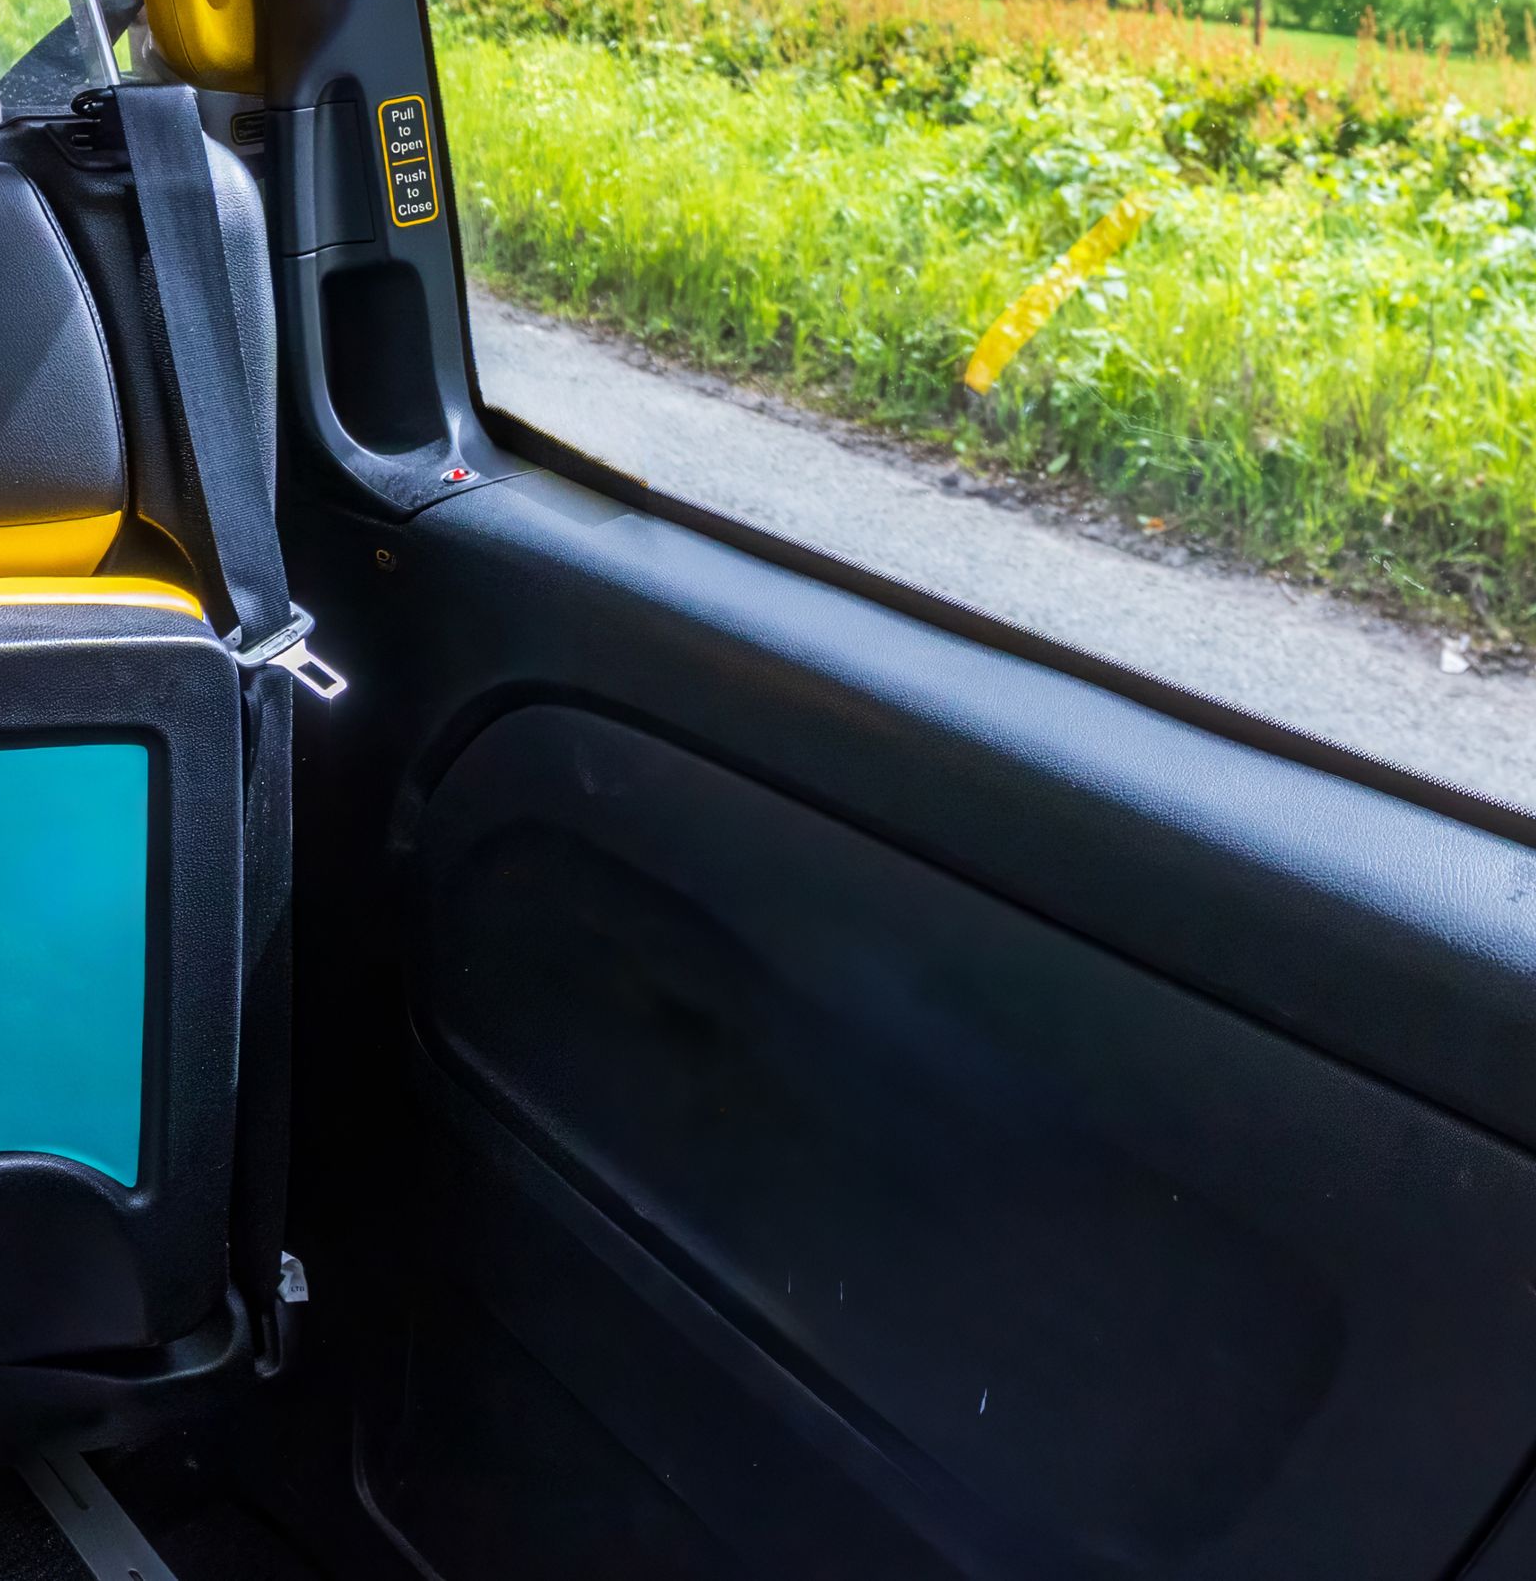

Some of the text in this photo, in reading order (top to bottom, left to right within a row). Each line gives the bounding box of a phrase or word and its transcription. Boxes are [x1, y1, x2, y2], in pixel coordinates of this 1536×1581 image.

[391, 107, 415, 122] Pull
[398, 126, 411, 137] to
[391, 139, 423, 154] Open
[395, 169, 427, 185] Push
[407, 187, 420, 198] to
[398, 199, 432, 216] Close
